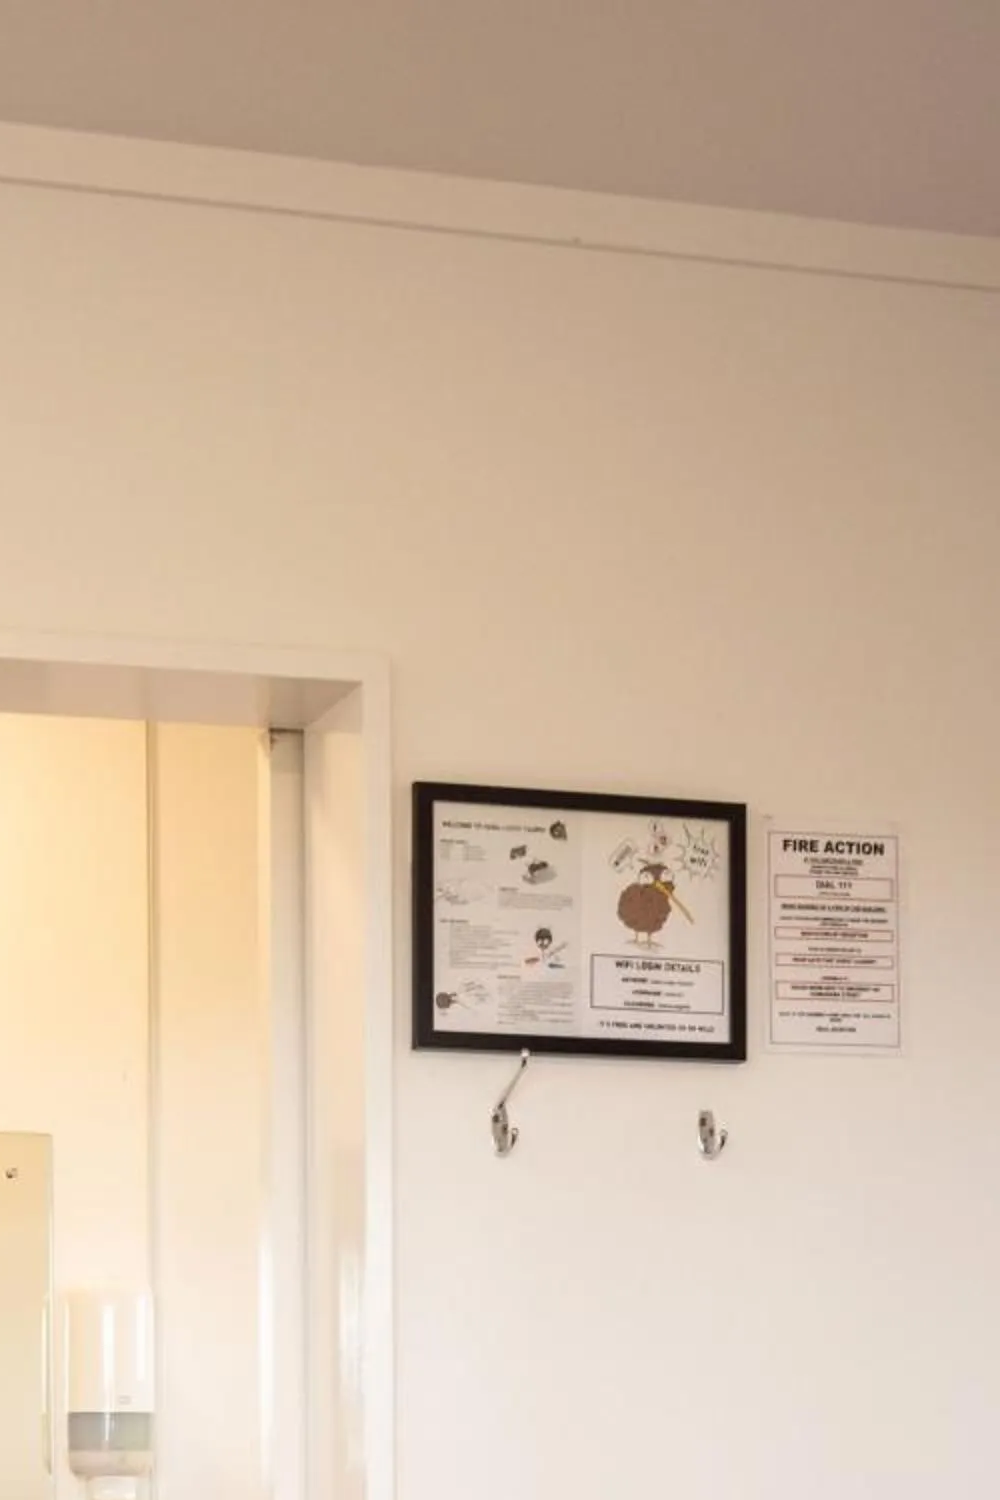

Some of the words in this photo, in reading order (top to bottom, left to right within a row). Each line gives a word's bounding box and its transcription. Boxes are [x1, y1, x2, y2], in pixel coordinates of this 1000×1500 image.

[782, 839, 820, 853] FIRE
[824, 840, 885, 855] ACTION
[636, 961, 662, 971] LOGIN
[664, 962, 701, 973] DETAILS
